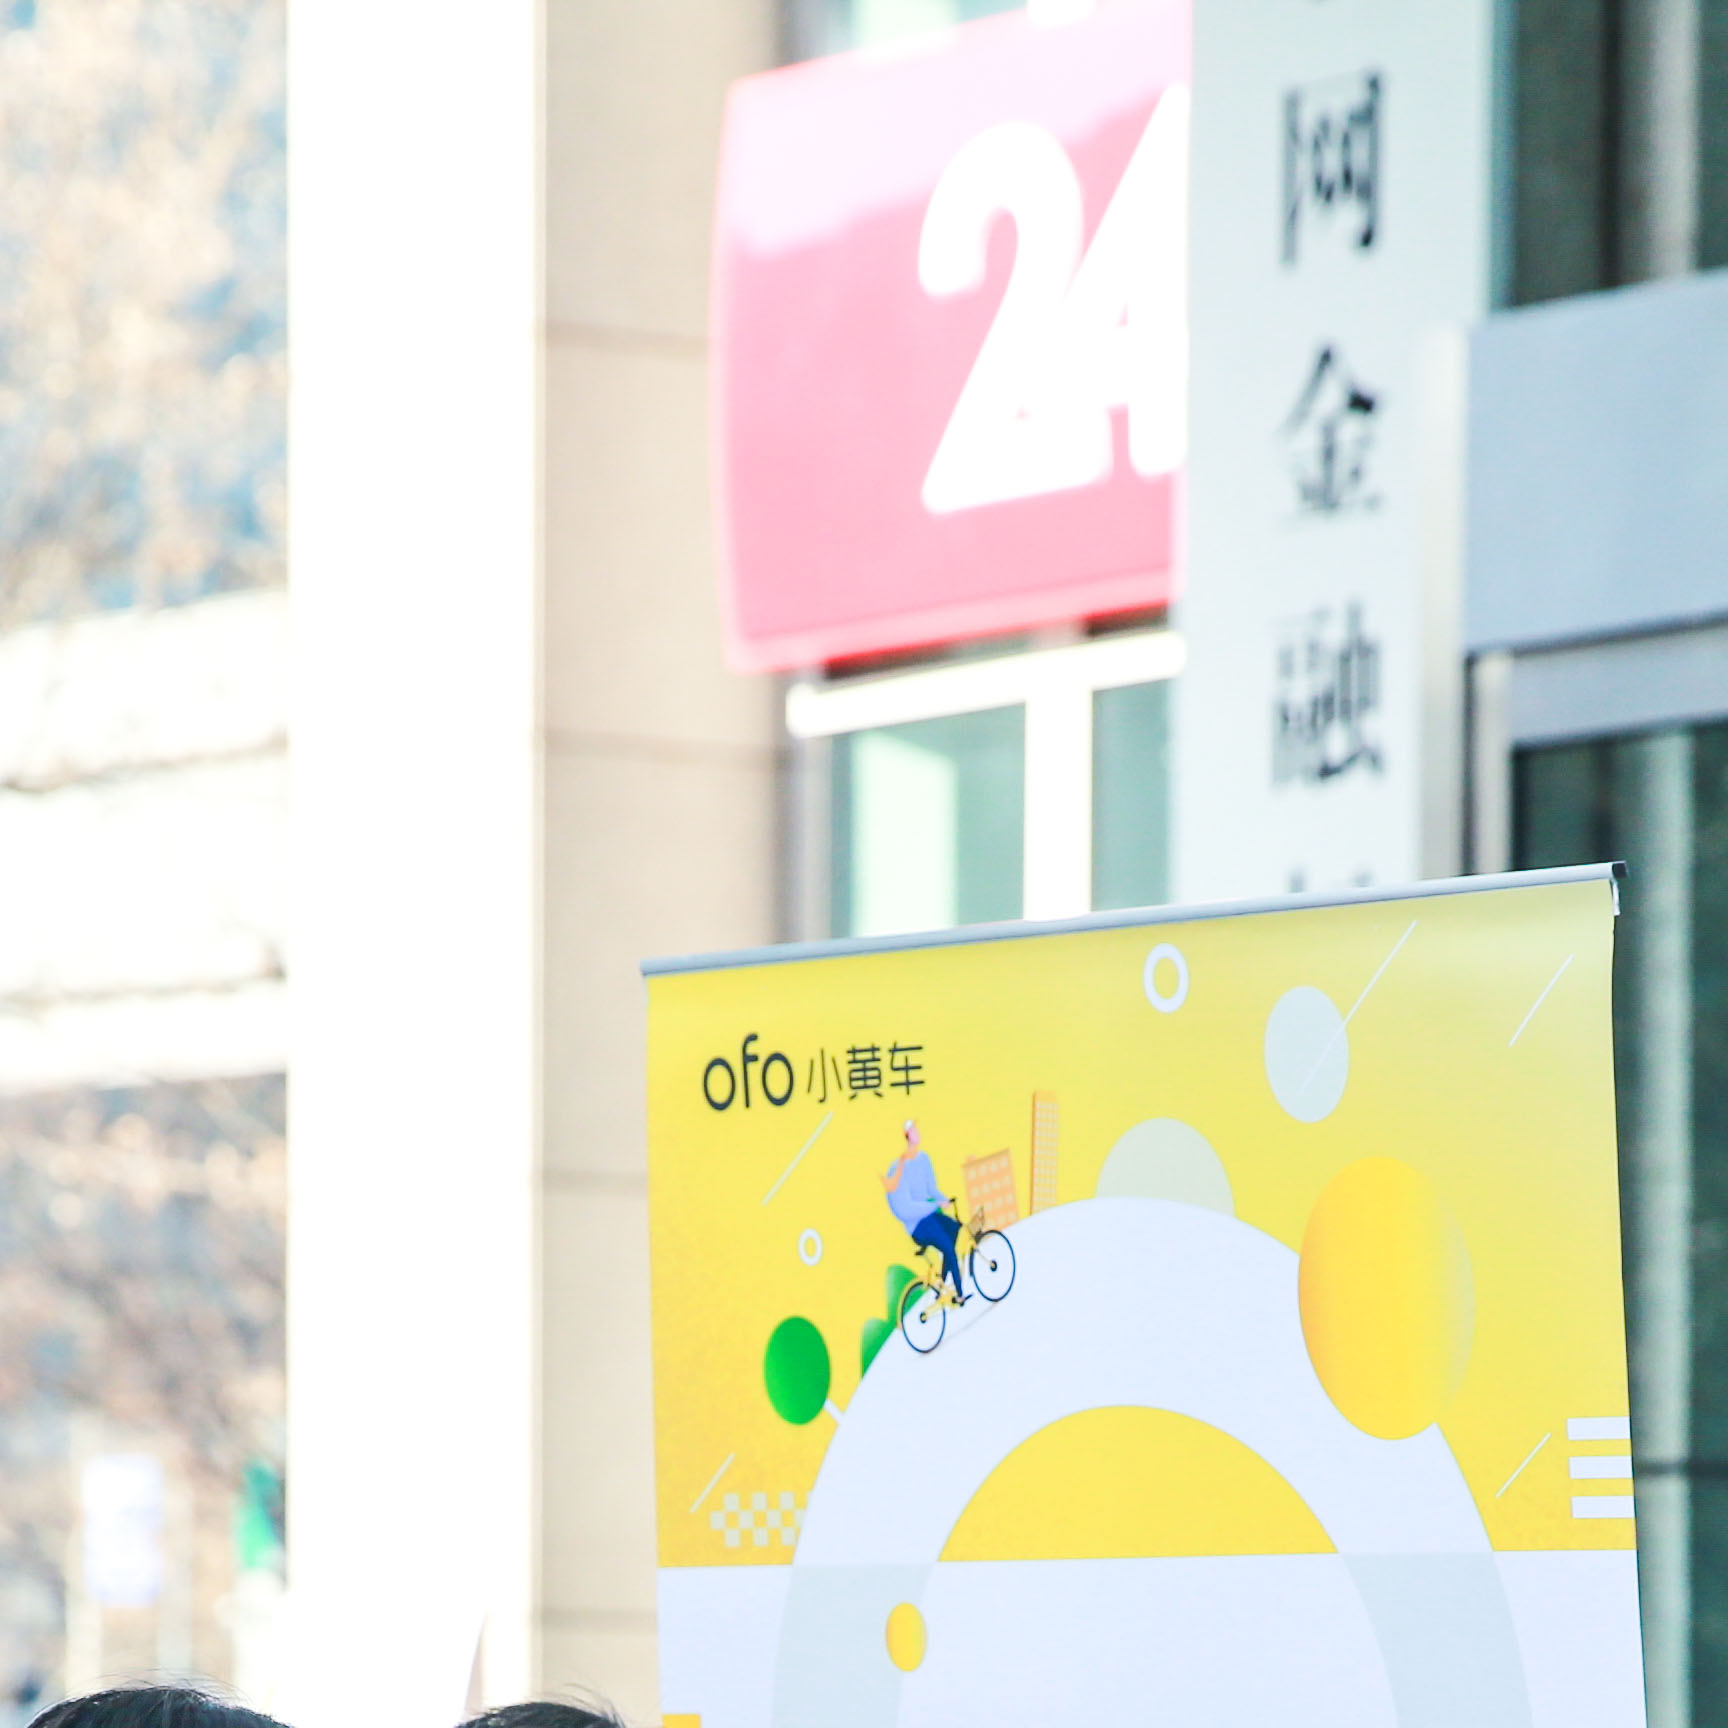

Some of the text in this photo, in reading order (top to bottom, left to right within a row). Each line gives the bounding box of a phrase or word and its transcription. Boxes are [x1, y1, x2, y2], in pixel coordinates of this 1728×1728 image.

[1275, 67, 1389, 893] 网金融
[703, 1033, 925, 1111] ofo 小黄车
